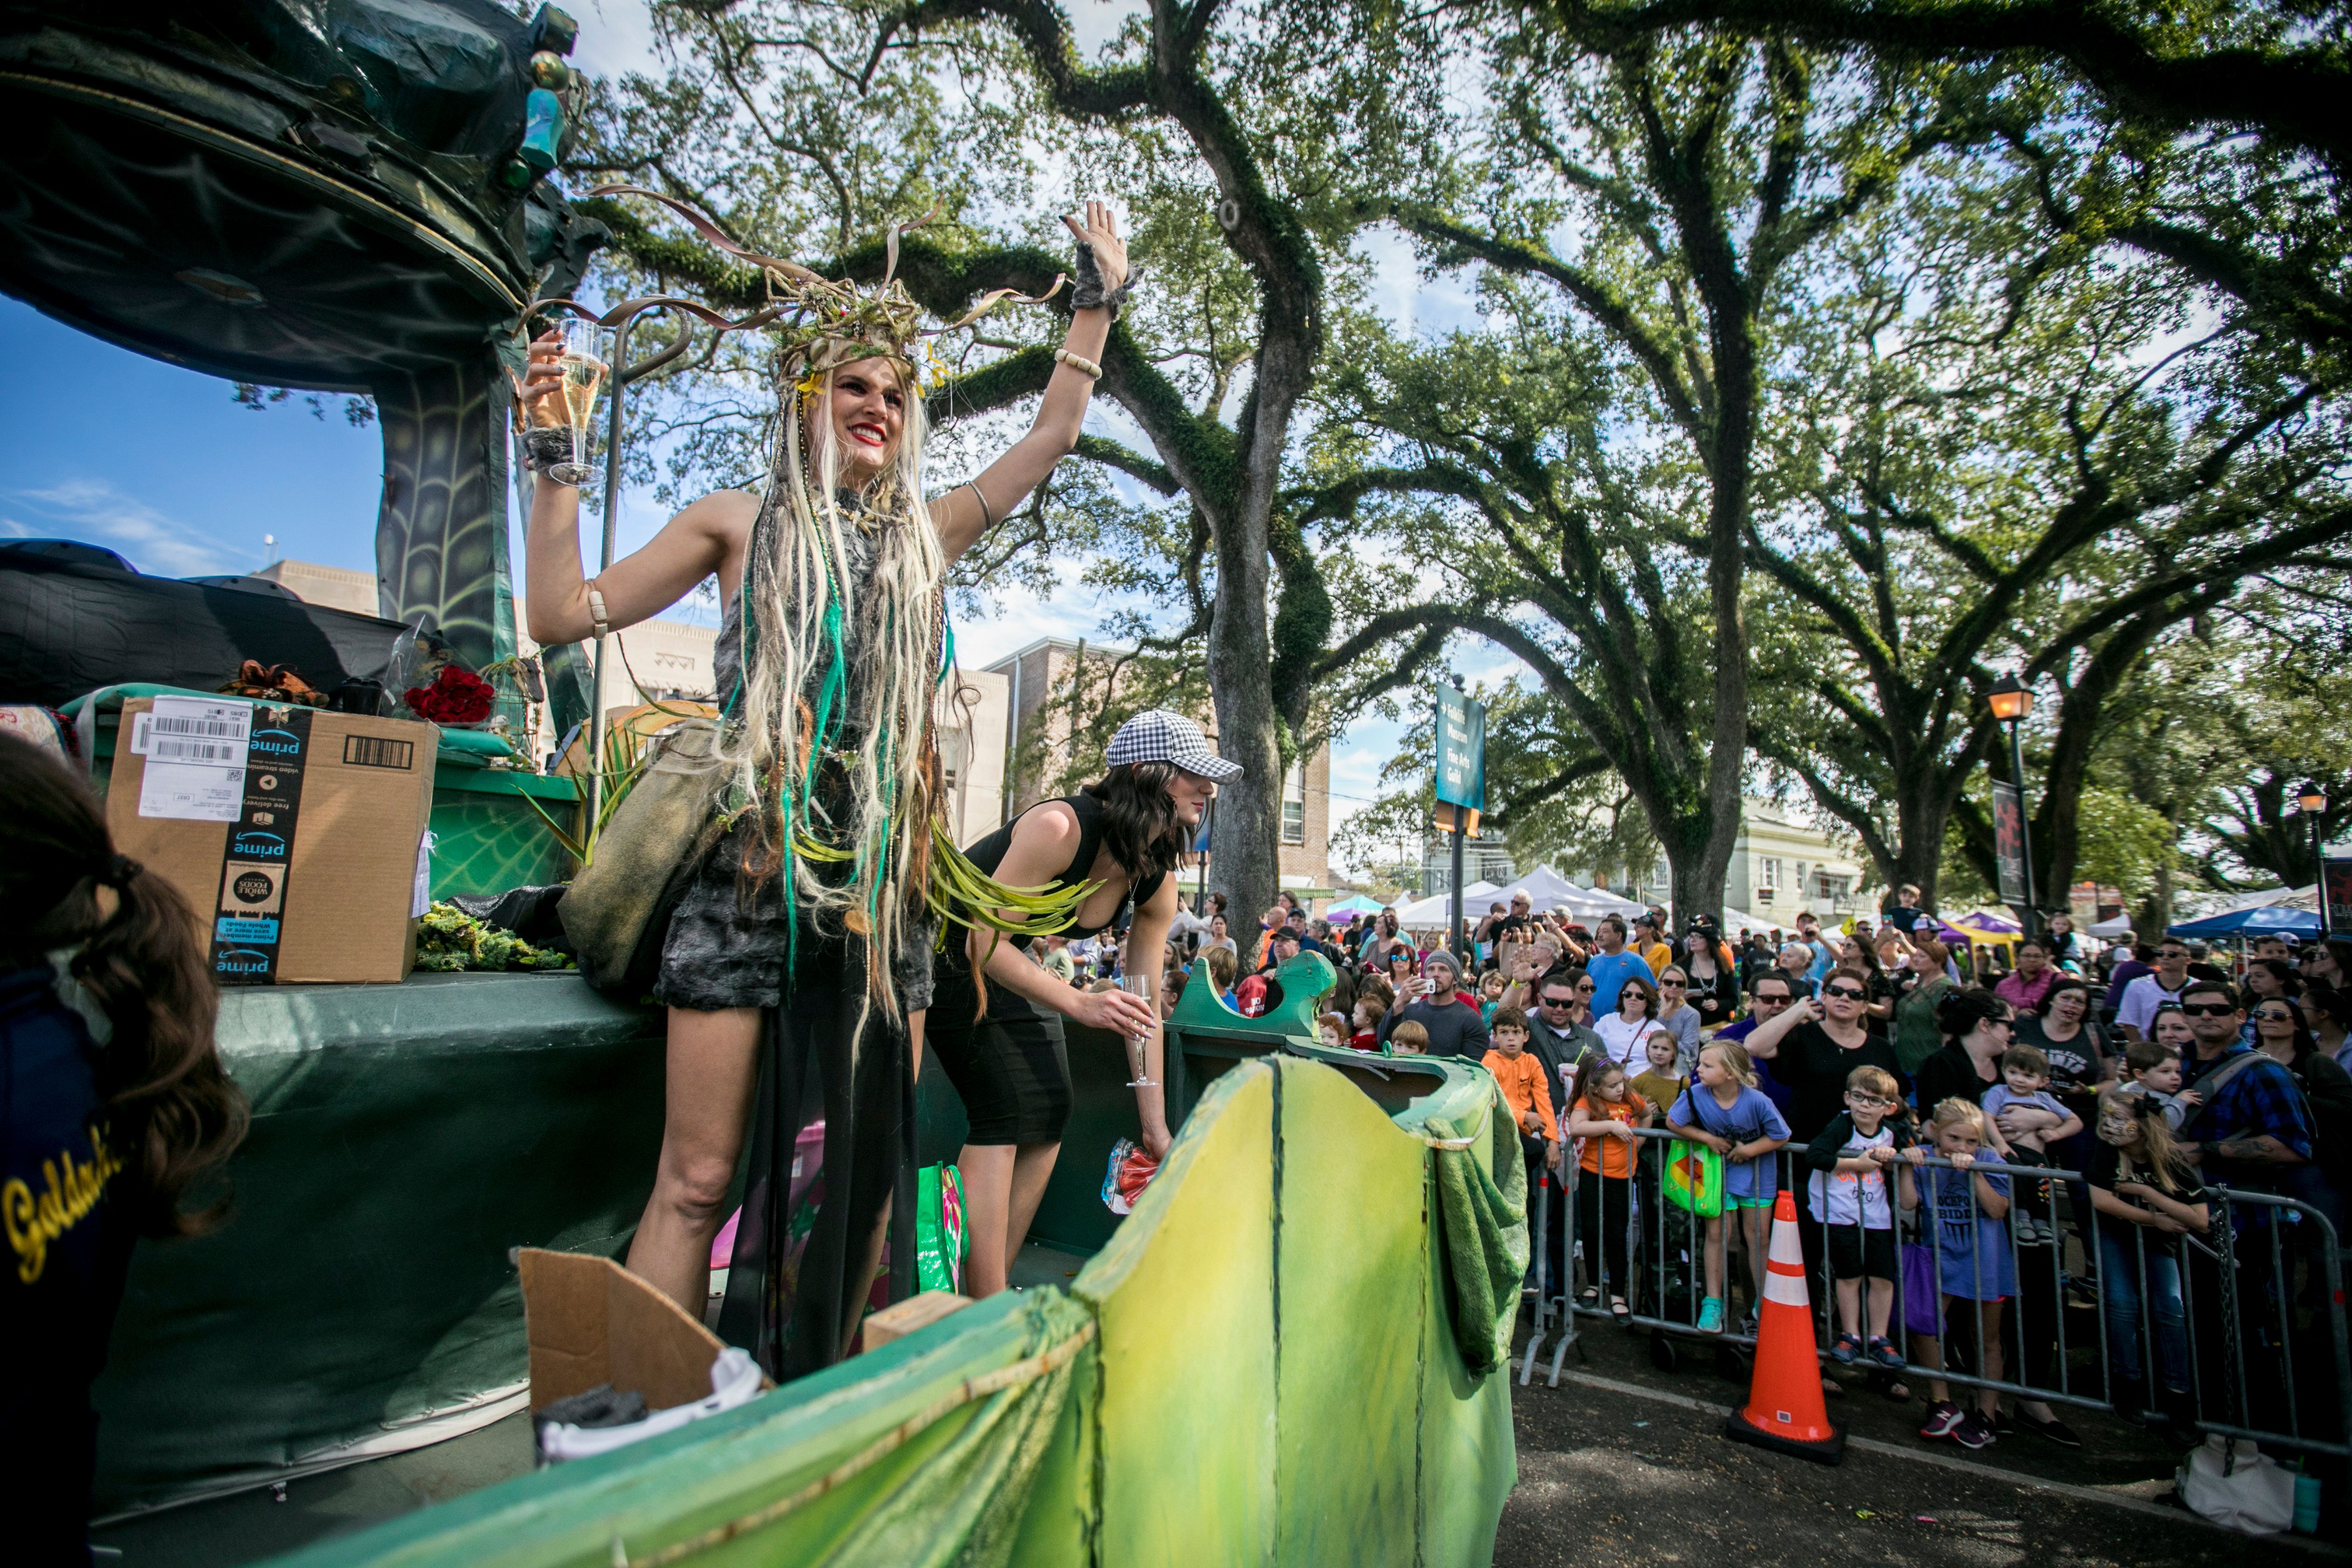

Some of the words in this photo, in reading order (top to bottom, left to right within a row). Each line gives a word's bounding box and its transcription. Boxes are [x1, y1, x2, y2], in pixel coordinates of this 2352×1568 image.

[1447, 703, 1465, 725] Folklife
[1447, 722, 1468, 744] Museum
[250, 740, 300, 755] prime
[1447, 747, 1459, 765] Fine
[1458, 752, 1470, 769] Arts
[1447, 767, 1461, 784] Guild
[243, 799, 272, 808] delivery
[234, 843, 285, 858] prime
[217, 960, 269, 975] prime
[1245, 1004, 1265, 1014] PARKIN
[1251, 997, 1261, 1006] NO
